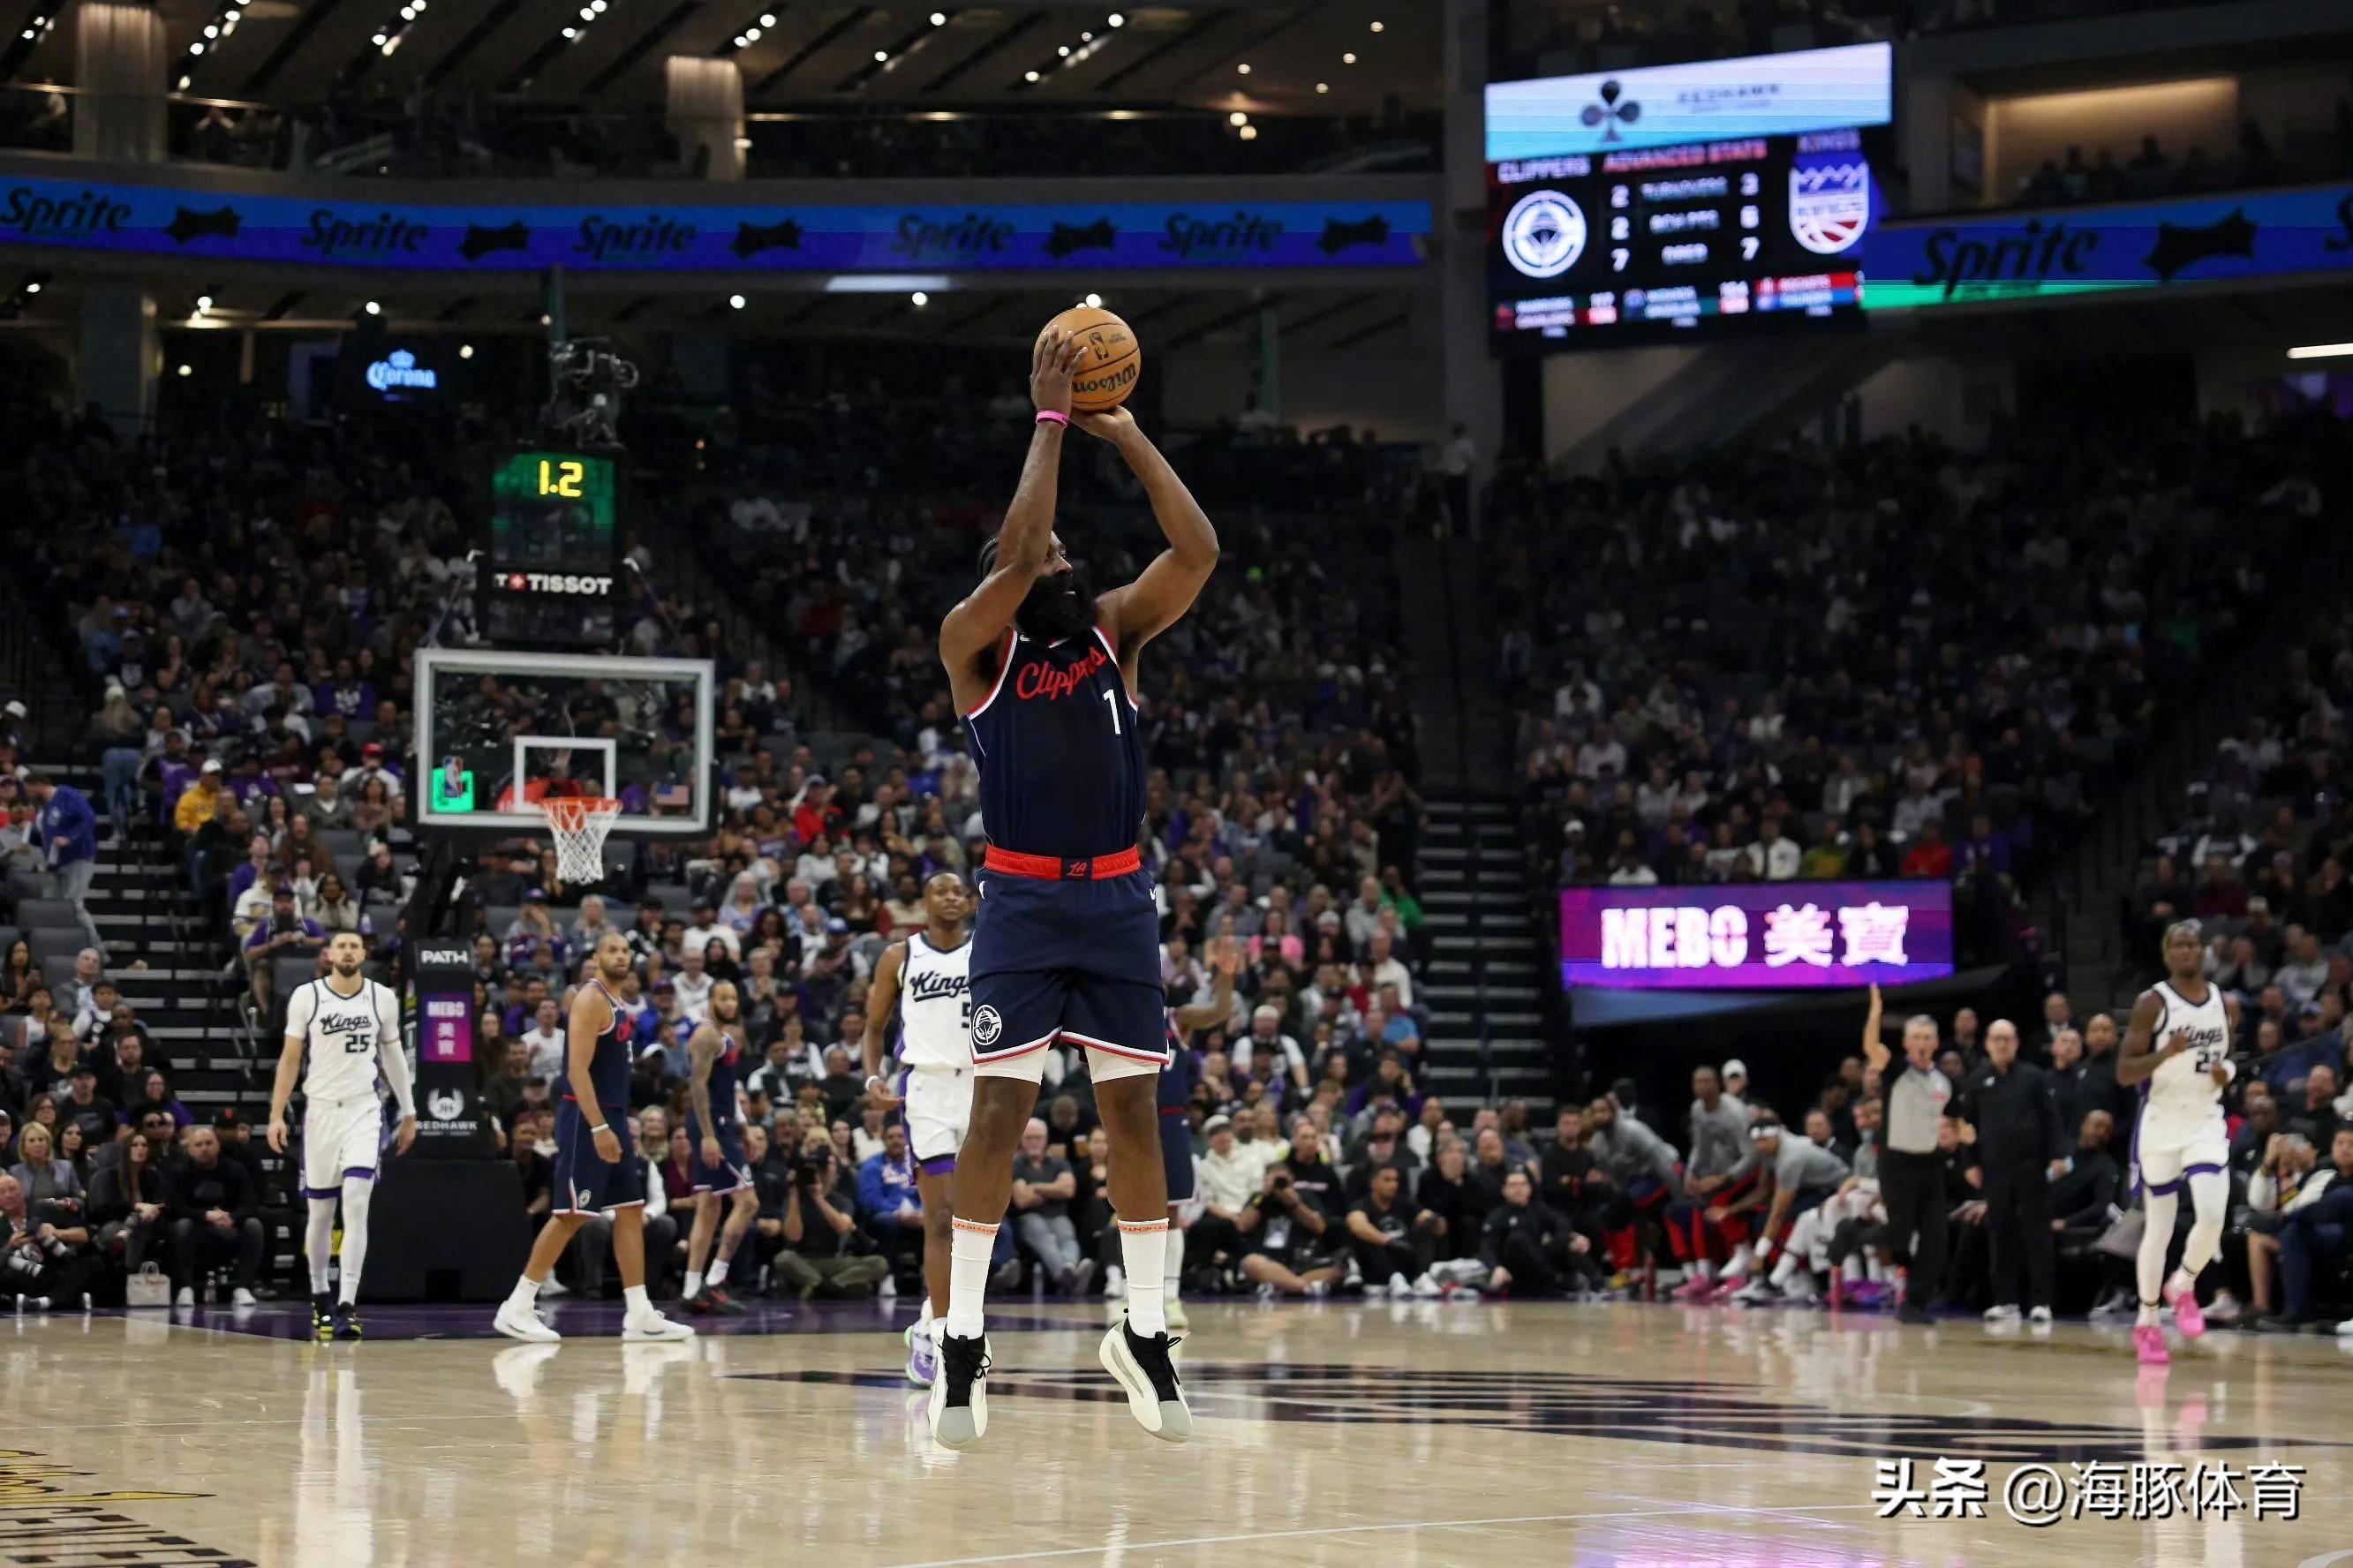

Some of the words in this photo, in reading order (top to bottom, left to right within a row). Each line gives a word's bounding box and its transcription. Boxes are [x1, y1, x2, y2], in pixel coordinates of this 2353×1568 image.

[0, 187, 132, 232] Sprite
[301, 208, 428, 254] Sprite
[572, 215, 698, 260] Sprite
[890, 213, 1015, 259] Sprite
[1159, 210, 1284, 257] Sprite
[1740, 236, 1760, 260] 7
[1610, 248, 1630, 272] 7
[1912, 219, 2100, 297] Sprite
[366, 362, 436, 390] Corona
[539, 460, 583, 497] 1.2
[527, 574, 613, 595] TISSOT
[1103, 689, 1121, 735] 1
[421, 950, 468, 964] PATH
[1601, 904, 1747, 969] MEBO
[1764, 901, 1910, 968] 美寶
[319, 1011, 372, 1035] Kings
[345, 1034, 371, 1053] 25
